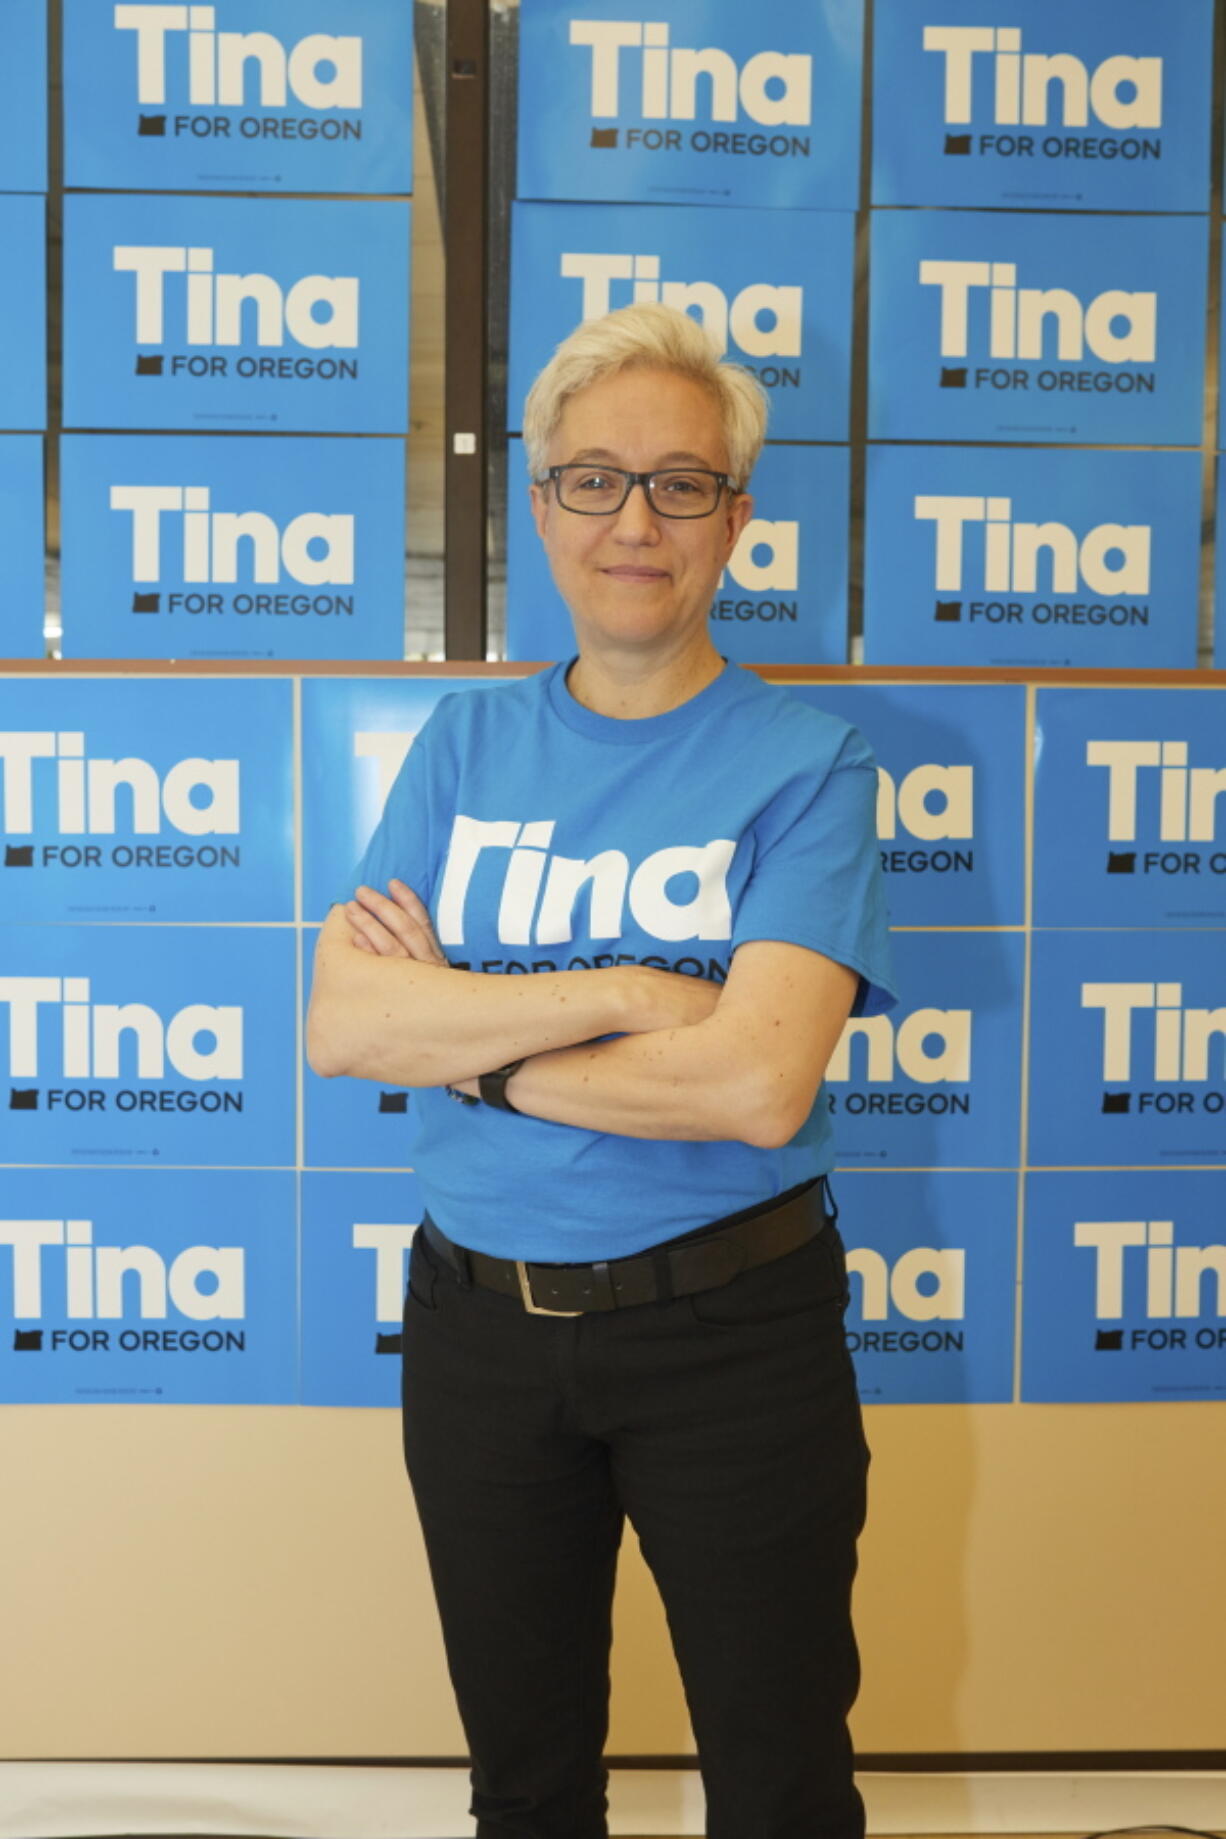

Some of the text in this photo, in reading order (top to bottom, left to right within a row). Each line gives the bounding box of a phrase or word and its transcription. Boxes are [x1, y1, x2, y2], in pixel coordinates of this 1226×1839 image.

[114, 5, 362, 109] Tina
[569, 20, 812, 125] Tina
[923, 26, 1163, 129] Tina
[174, 116, 361, 140] FOR OREGON
[626, 128, 810, 156] FOR OREGON
[980, 135, 1161, 159] FOR OREGON
[113, 246, 359, 348] Tina
[919, 261, 1157, 363] Tina
[172, 356, 358, 380] FOR OREGON
[976, 369, 1154, 393] FOR OREGON
[111, 486, 354, 585] Tina
[915, 496, 1151, 595] Tina
[168, 594, 354, 616] FOR OREGON
[710, 600, 797, 622] EGON
[970, 602, 1149, 625] FOR OREGON
[0, 732, 239, 835] Tina
[1087, 741, 1226, 841] Tin
[43, 846, 240, 868] FOR OREGON
[437, 815, 737, 946] Tina
[1144, 853, 1200, 874] FOR
[0, 978, 242, 1080] Tina
[825, 1008, 971, 1083] na
[1082, 983, 1226, 1081] Tin
[47, 1090, 242, 1113] FOR OREGON
[845, 1093, 969, 1115] OREGON
[1139, 1092, 1194, 1114] FOR
[0, 1221, 244, 1320] Tina
[1074, 1221, 1226, 1319] Tin
[52, 1330, 245, 1352] FOR OREGON
[1131, 1329, 1186, 1351] FOR
